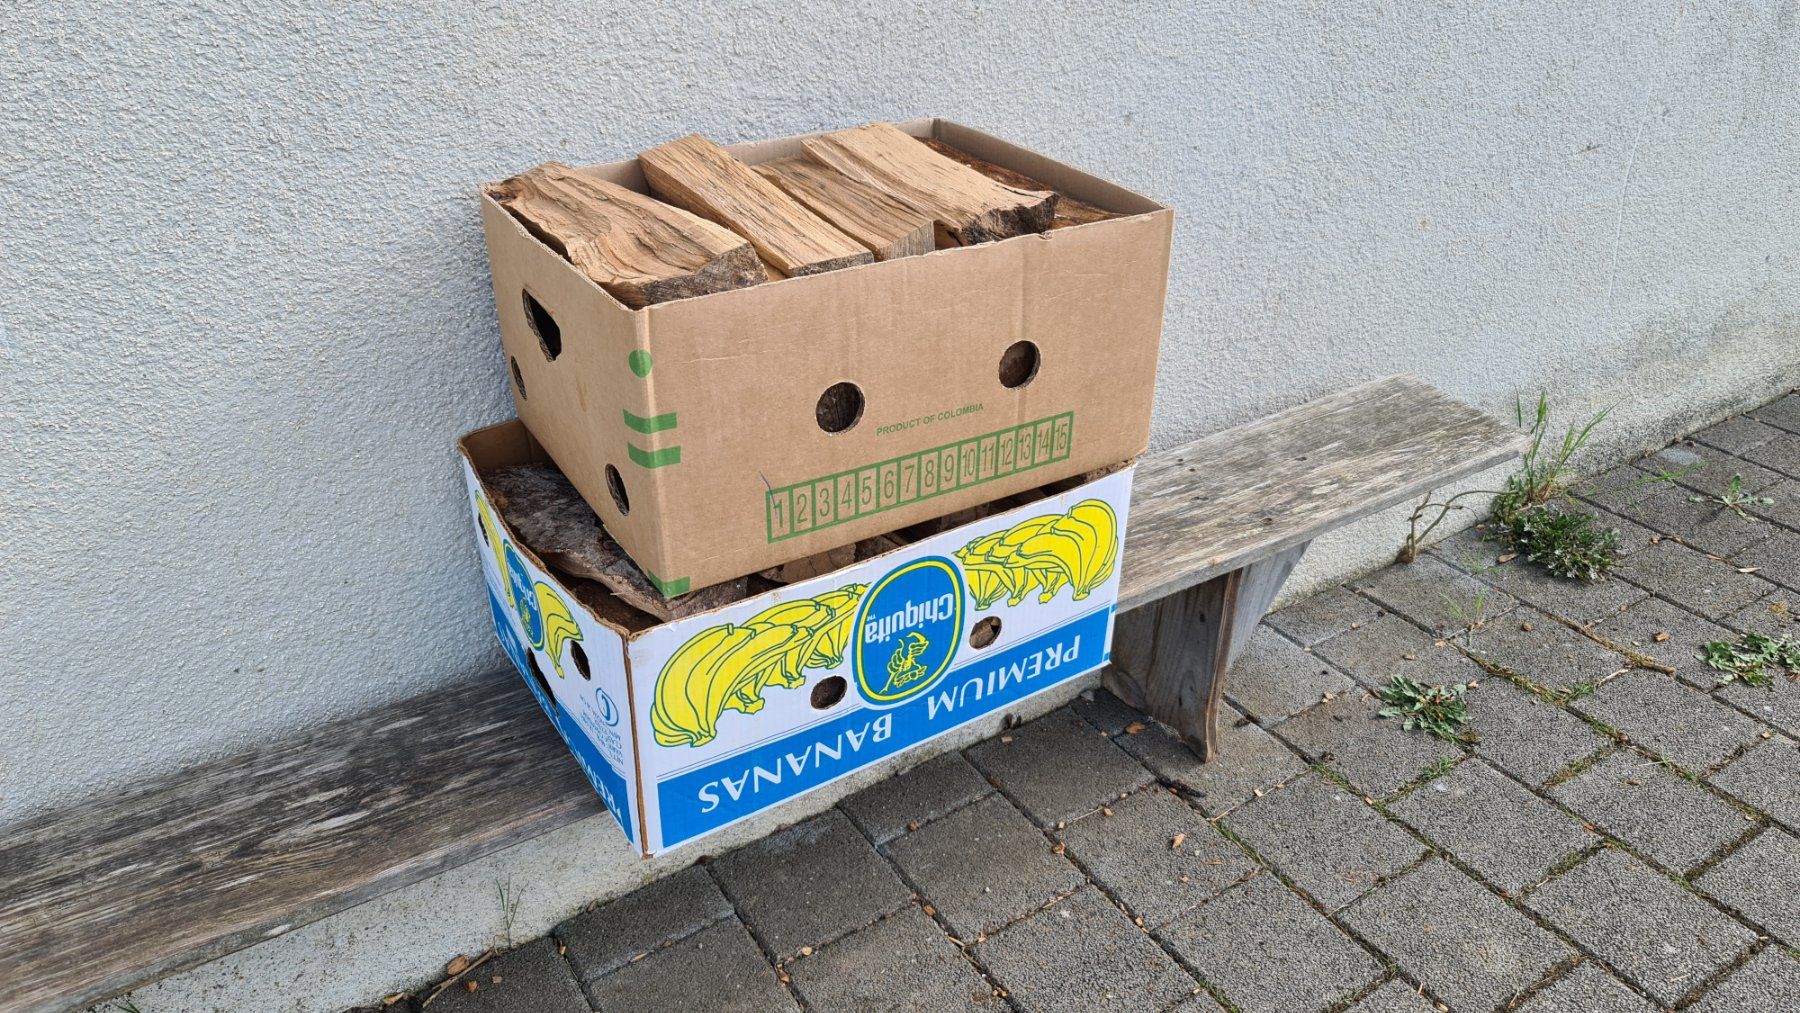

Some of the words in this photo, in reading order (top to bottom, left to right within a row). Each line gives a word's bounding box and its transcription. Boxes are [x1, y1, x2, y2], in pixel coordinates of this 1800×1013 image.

[876, 418, 921, 436] PRODUCT
[922, 415, 935, 425] OF
[937, 403, 984, 421] COLOMBIA
[774, 498, 784, 528] 1
[796, 493, 808, 524] 2
[819, 488, 830, 517] 3
[841, 481, 852, 509] 4
[862, 475, 872, 505] 5
[883, 469, 894, 498] 6
[904, 464, 915, 493] 7
[924, 459, 935, 487] 8
[944, 454, 954, 482] 9
[962, 449, 975, 477] 10
[982, 444, 994, 472] 11
[1001, 438, 1014, 466] 12
[1018, 433, 1032, 461] 13
[1037, 428, 1049, 455] 14
[1055, 423, 1067, 451] 15
[865, 593, 954, 644] Chiquita
[928, 634, 1081, 721] PREMIUM
[700, 712, 893, 813] BANANAS
